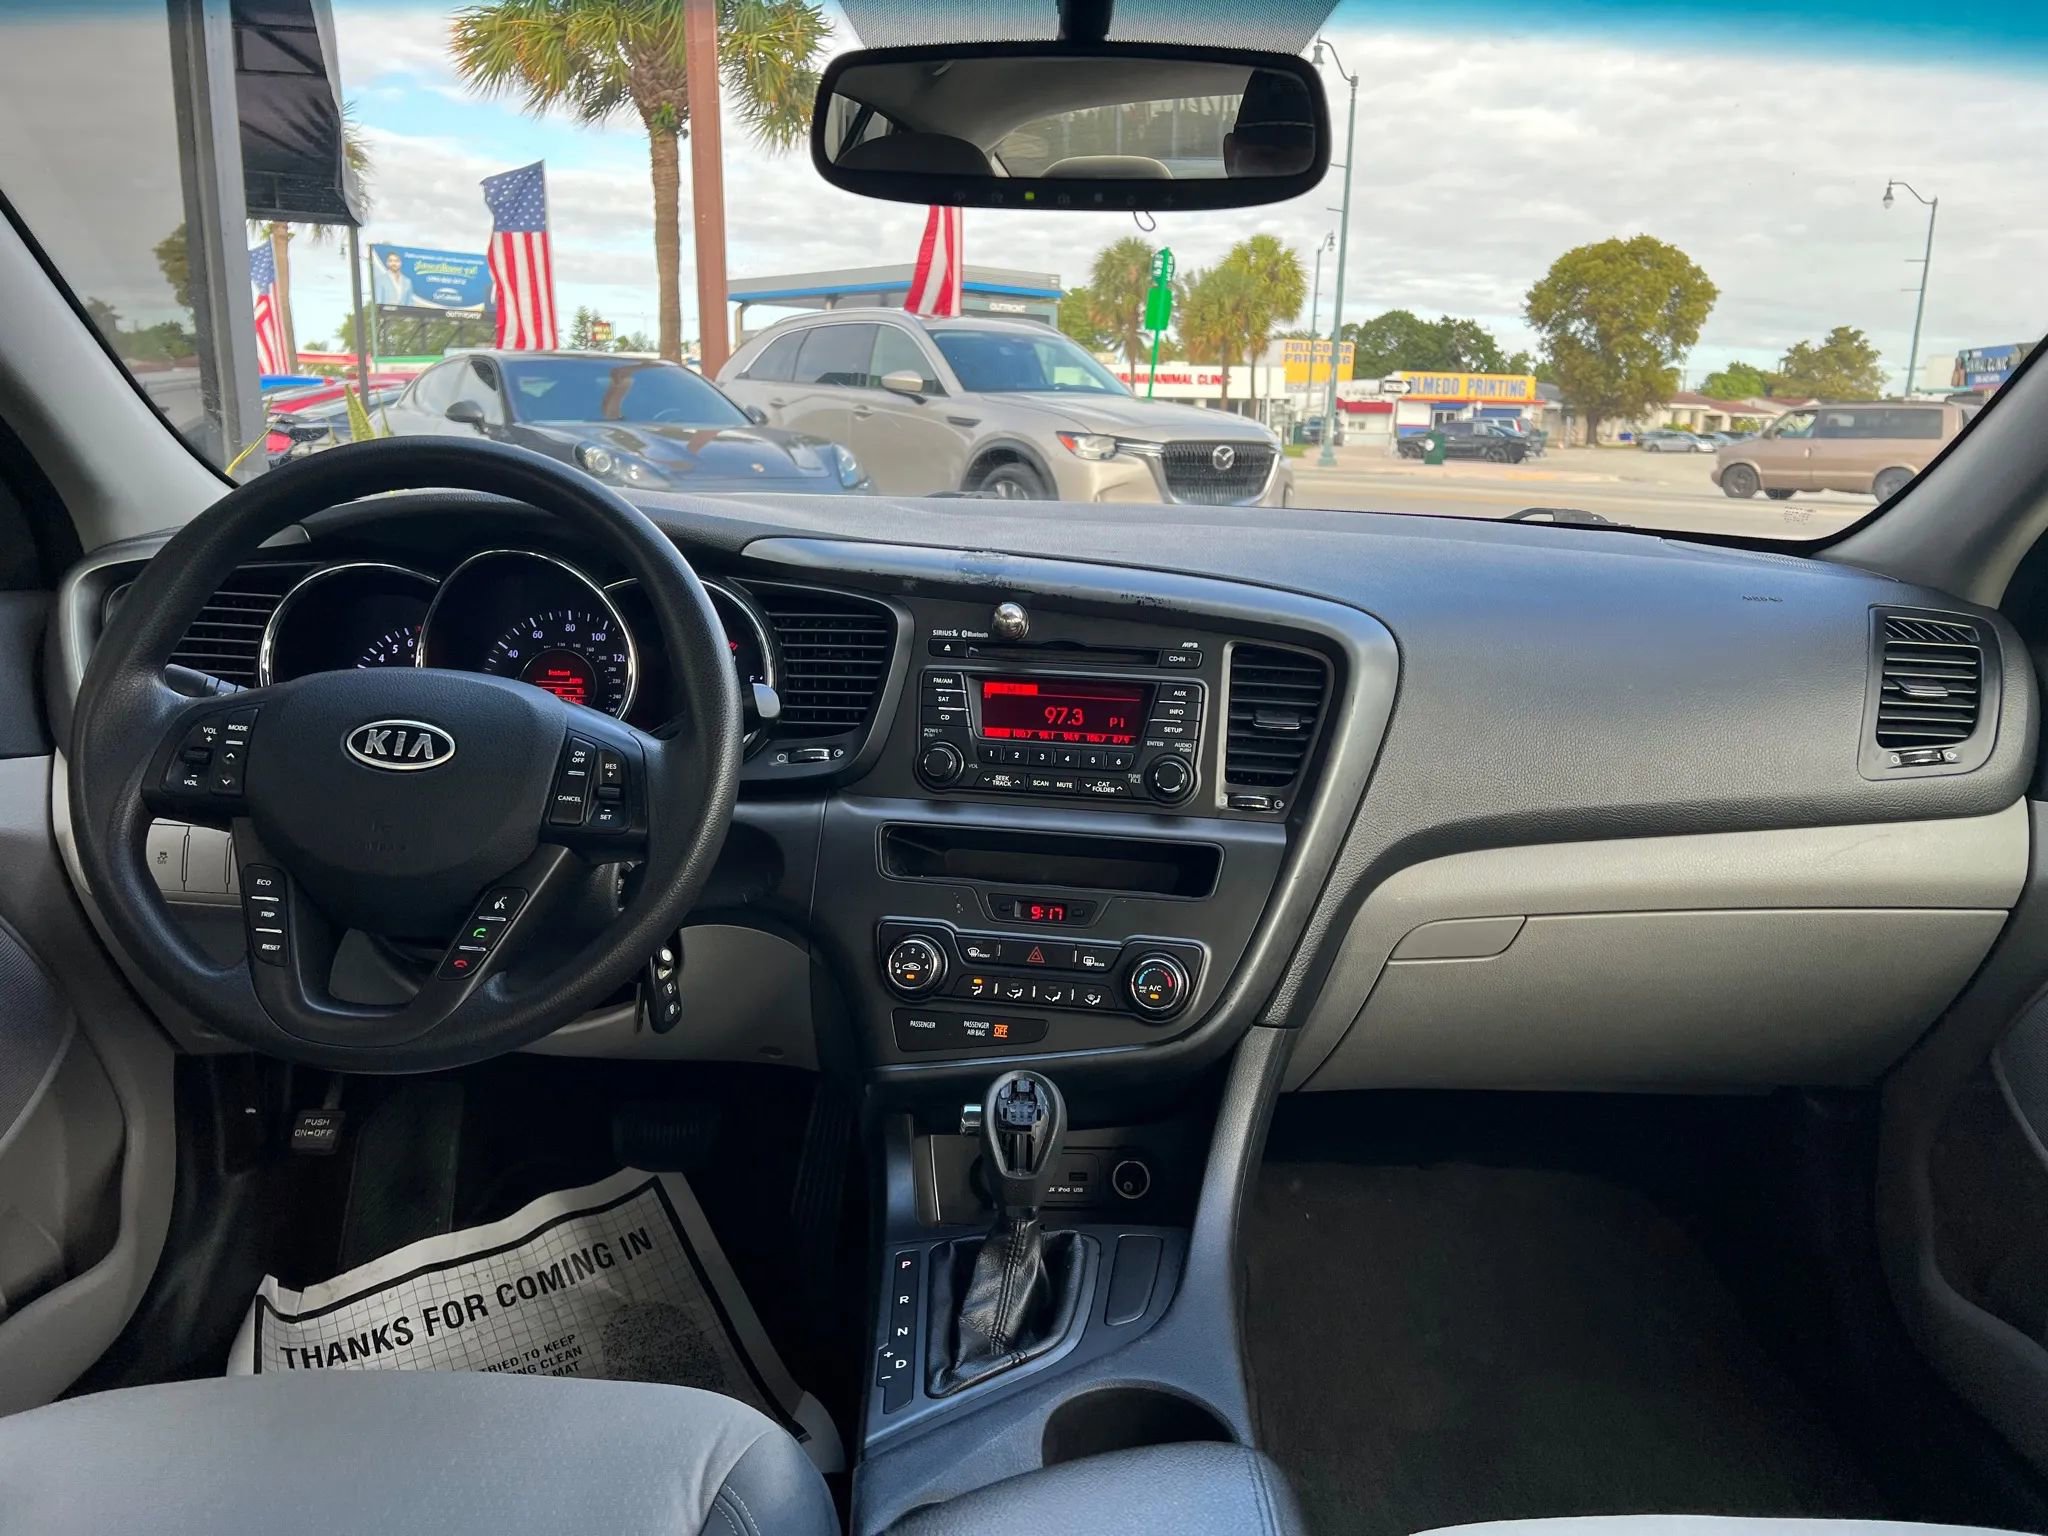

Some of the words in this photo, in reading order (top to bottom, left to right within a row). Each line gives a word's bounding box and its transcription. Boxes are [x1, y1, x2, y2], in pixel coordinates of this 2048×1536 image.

[1285, 353, 1351, 365] PRINTIG
[1197, 374, 1232, 385] CLINC
[1467, 378, 1527, 397] PRINTING
[565, 624, 576, 632] 80
[532, 630, 543, 639] 60
[591, 633, 606, 641] 100
[932, 629, 953, 637] SIRIUS
[407, 638, 414, 647] 6
[392, 644, 399, 654] 5
[378, 654, 385, 662] 4
[508, 650, 519, 659] 40
[1173, 689, 1187, 697] AUX
[1044, 706, 1084, 725] 97.3
[203, 726, 218, 735] VOL
[364, 729, 434, 760] KIA
[256, 878, 272, 886] ECO
[1031, 906, 1063, 920] 9:17
[261, 943, 281, 951] RESET
[909, 1020, 936, 1029] PASSENGER
[963, 1020, 990, 1029] PASSENGER
[994, 1027, 1008, 1035] OFF
[304, 1118, 330, 1126] PUSH
[901, 1260, 911, 1269] P
[280, 1316, 415, 1370] THANKS
[422, 1293, 489, 1337] FOR
[495, 1243, 617, 1308] COMING
[618, 1227, 654, 1261] IN
[899, 1295, 910, 1304] R
[897, 1326, 908, 1337] N
[523, 1348, 540, 1362] TO
[543, 1334, 576, 1354] KEEP
[540, 1345, 582, 1369] CLEAN
[895, 1359, 907, 1369] D
[552, 1361, 580, 1377] MAT
